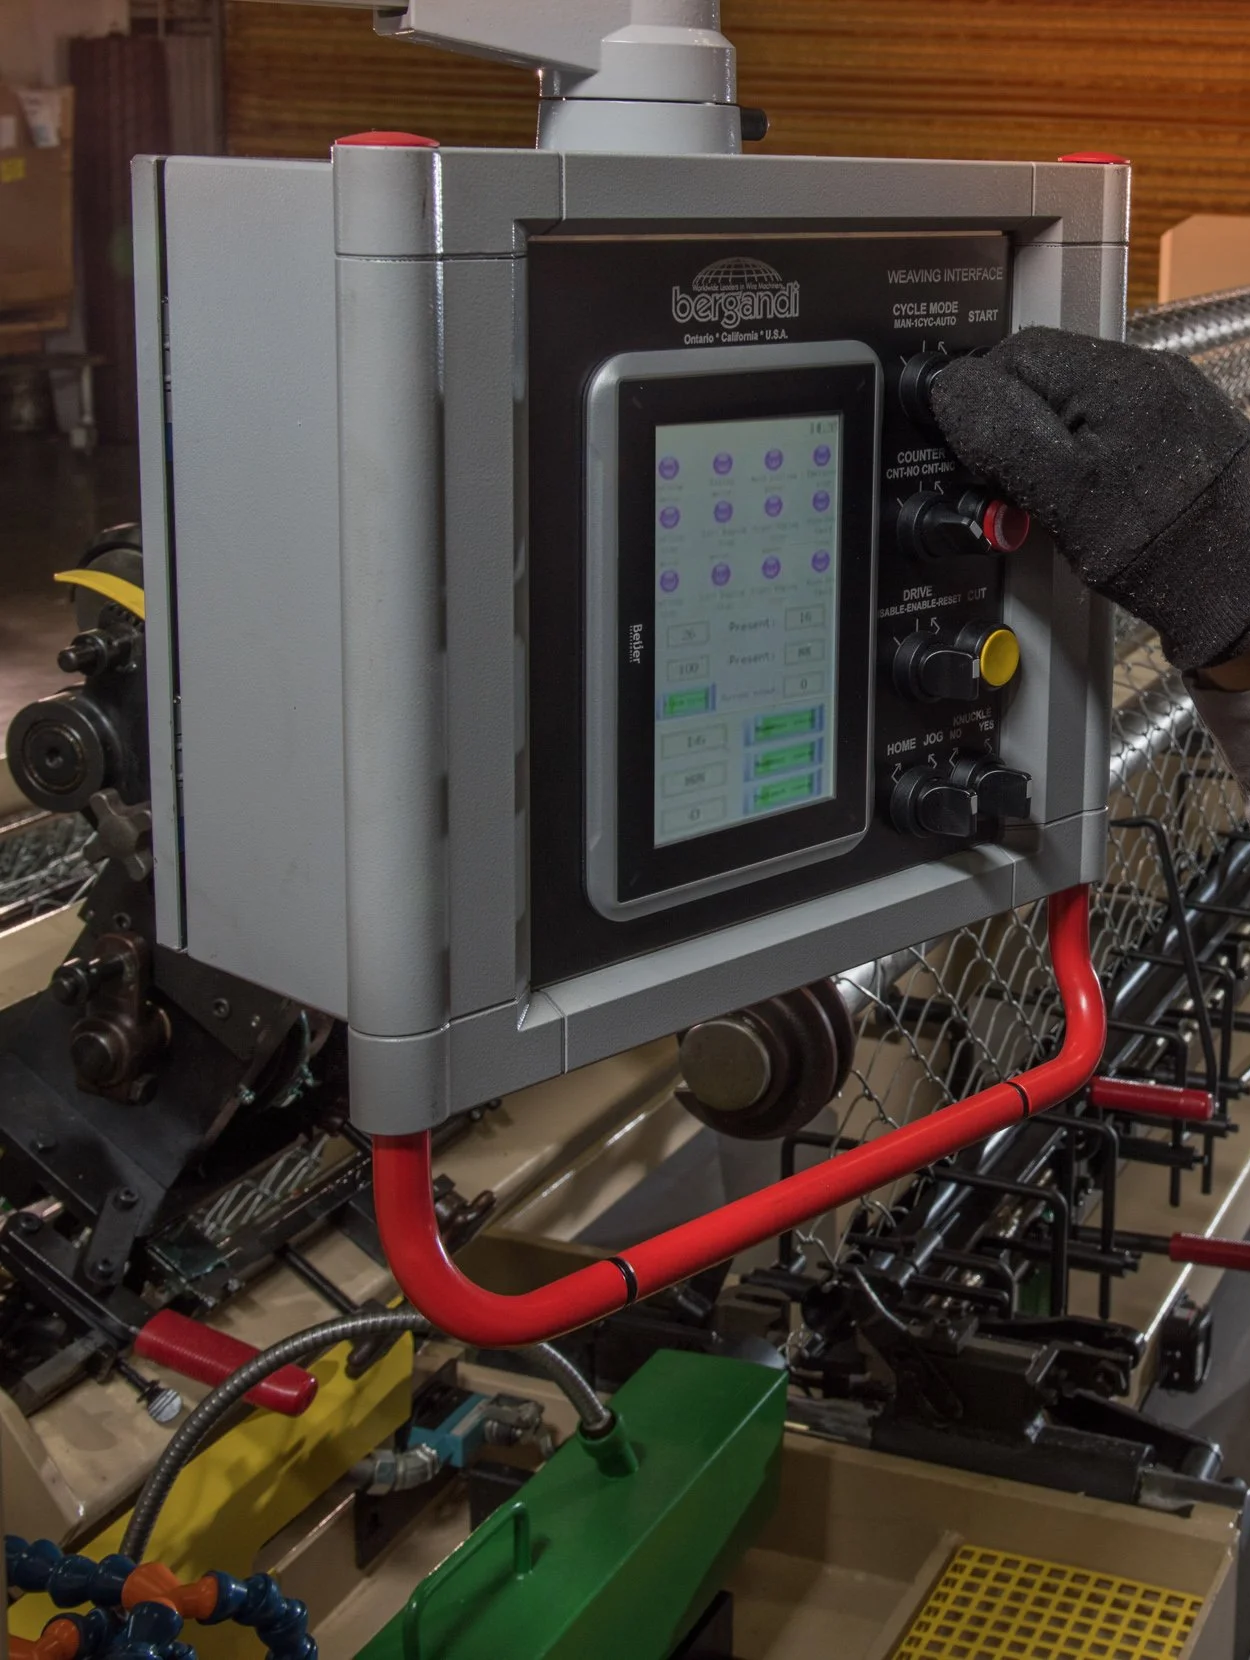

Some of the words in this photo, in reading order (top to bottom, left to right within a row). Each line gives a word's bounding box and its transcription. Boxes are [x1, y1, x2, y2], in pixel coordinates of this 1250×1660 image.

[888, 269, 941, 283] WEAVING
[944, 267, 1003, 281] INTERFACE
[672, 280, 800, 329] bergandi
[893, 303, 926, 315] CYCLE
[929, 301, 959, 314] MODE
[894, 316, 956, 328] MAN-1CYC-AUTO
[968, 309, 999, 323] START
[684, 332, 714, 345] Ontario
[721, 330, 758, 343] California
[765, 328, 788, 340] U.S.A.
[897, 448, 946, 463] COUNTER
[886, 463, 920, 480] CNT-NO
[903, 585, 932, 601] DRIVE
[967, 587, 988, 601] CUT
[879, 594, 961, 618] SABLE-ENABLE-RESET
[633, 623, 643, 664] Beijer
[953, 707, 992, 727] KNUCKLE
[950, 728, 961, 739] NO
[979, 721, 994, 732] YES
[887, 738, 917, 756] HOME
[923, 731, 944, 746] JOG
